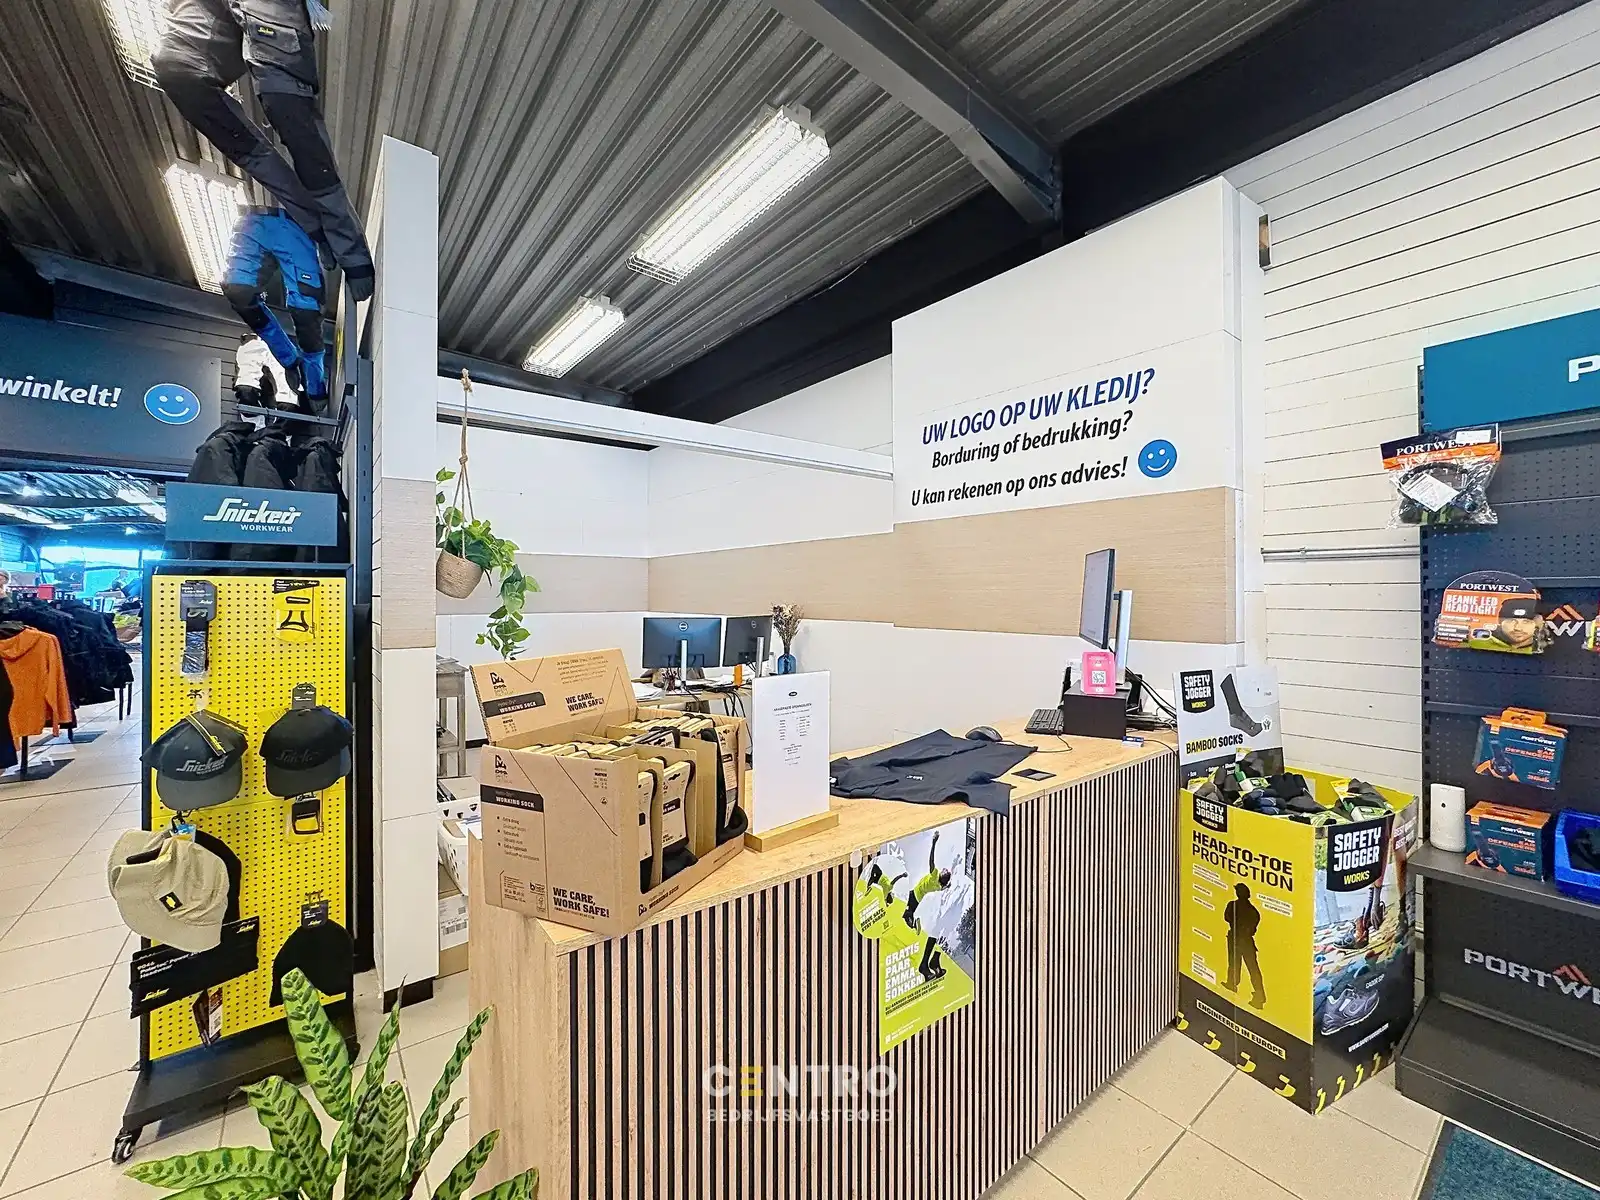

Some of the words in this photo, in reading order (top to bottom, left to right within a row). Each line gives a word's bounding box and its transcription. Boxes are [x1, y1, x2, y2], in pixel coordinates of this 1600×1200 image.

[922, 421, 948, 445] UW
[950, 409, 996, 439] LOGO
[1000, 401, 1026, 427] OP
[1029, 391, 1064, 421] UW
[1066, 367, 1155, 413] KLEDIJ?
[932, 441, 1000, 468] Borduring
[1003, 432, 1021, 455] of
[1021, 410, 1133, 451] bedrukking?
[911, 490, 921, 506] U
[922, 485, 946, 505] kan
[948, 480, 1002, 502] rekenen
[1005, 477, 1024, 497] op
[1028, 471, 1057, 490] ons
[1061, 456, 1128, 485] advies!
[203, 498, 302, 525] Snickers
[240, 524, 293, 533] WORKWEAR
[1460, 583, 1519, 592] PORTWEST
[1445, 603, 1469, 612] HEAD
[1470, 604, 1497, 615] LIGHT
[1480, 596, 1498, 606] LED
[1183, 675, 1210, 688] SAFETY
[565, 696, 576, 704] WE
[1185, 686, 1211, 700] JOGGER
[568, 702, 587, 712] WORK
[1186, 738, 1217, 754] BAMBOO
[1218, 734, 1244, 748] SOCKS
[496, 796, 520, 806] WORKING
[520, 800, 534, 808] SOCK
[1196, 798, 1224, 815] SAFETY
[1196, 807, 1224, 824] JOGGER
[1334, 826, 1382, 852] SAFETY
[1192, 830, 1292, 876] HEAD-TO-TOE
[1334, 846, 1380, 872] JOGGER
[1192, 844, 1293, 892] PROTECTION
[1344, 870, 1370, 884] WORKS
[553, 887, 568, 898] WE
[570, 891, 596, 906] CARE,
[553, 897, 581, 911] WORK
[583, 904, 610, 918] SAFE!
[886, 942, 920, 967] GRATIS
[886, 958, 910, 979] PAAR
[886, 966, 919, 991] EMMA-
[885, 974, 925, 1003] SOKKEN
[1198, 1002, 1240, 1032] ENGINEERED
[1241, 1028, 1250, 1038] IN
[1252, 1034, 1283, 1056] EUROPE
